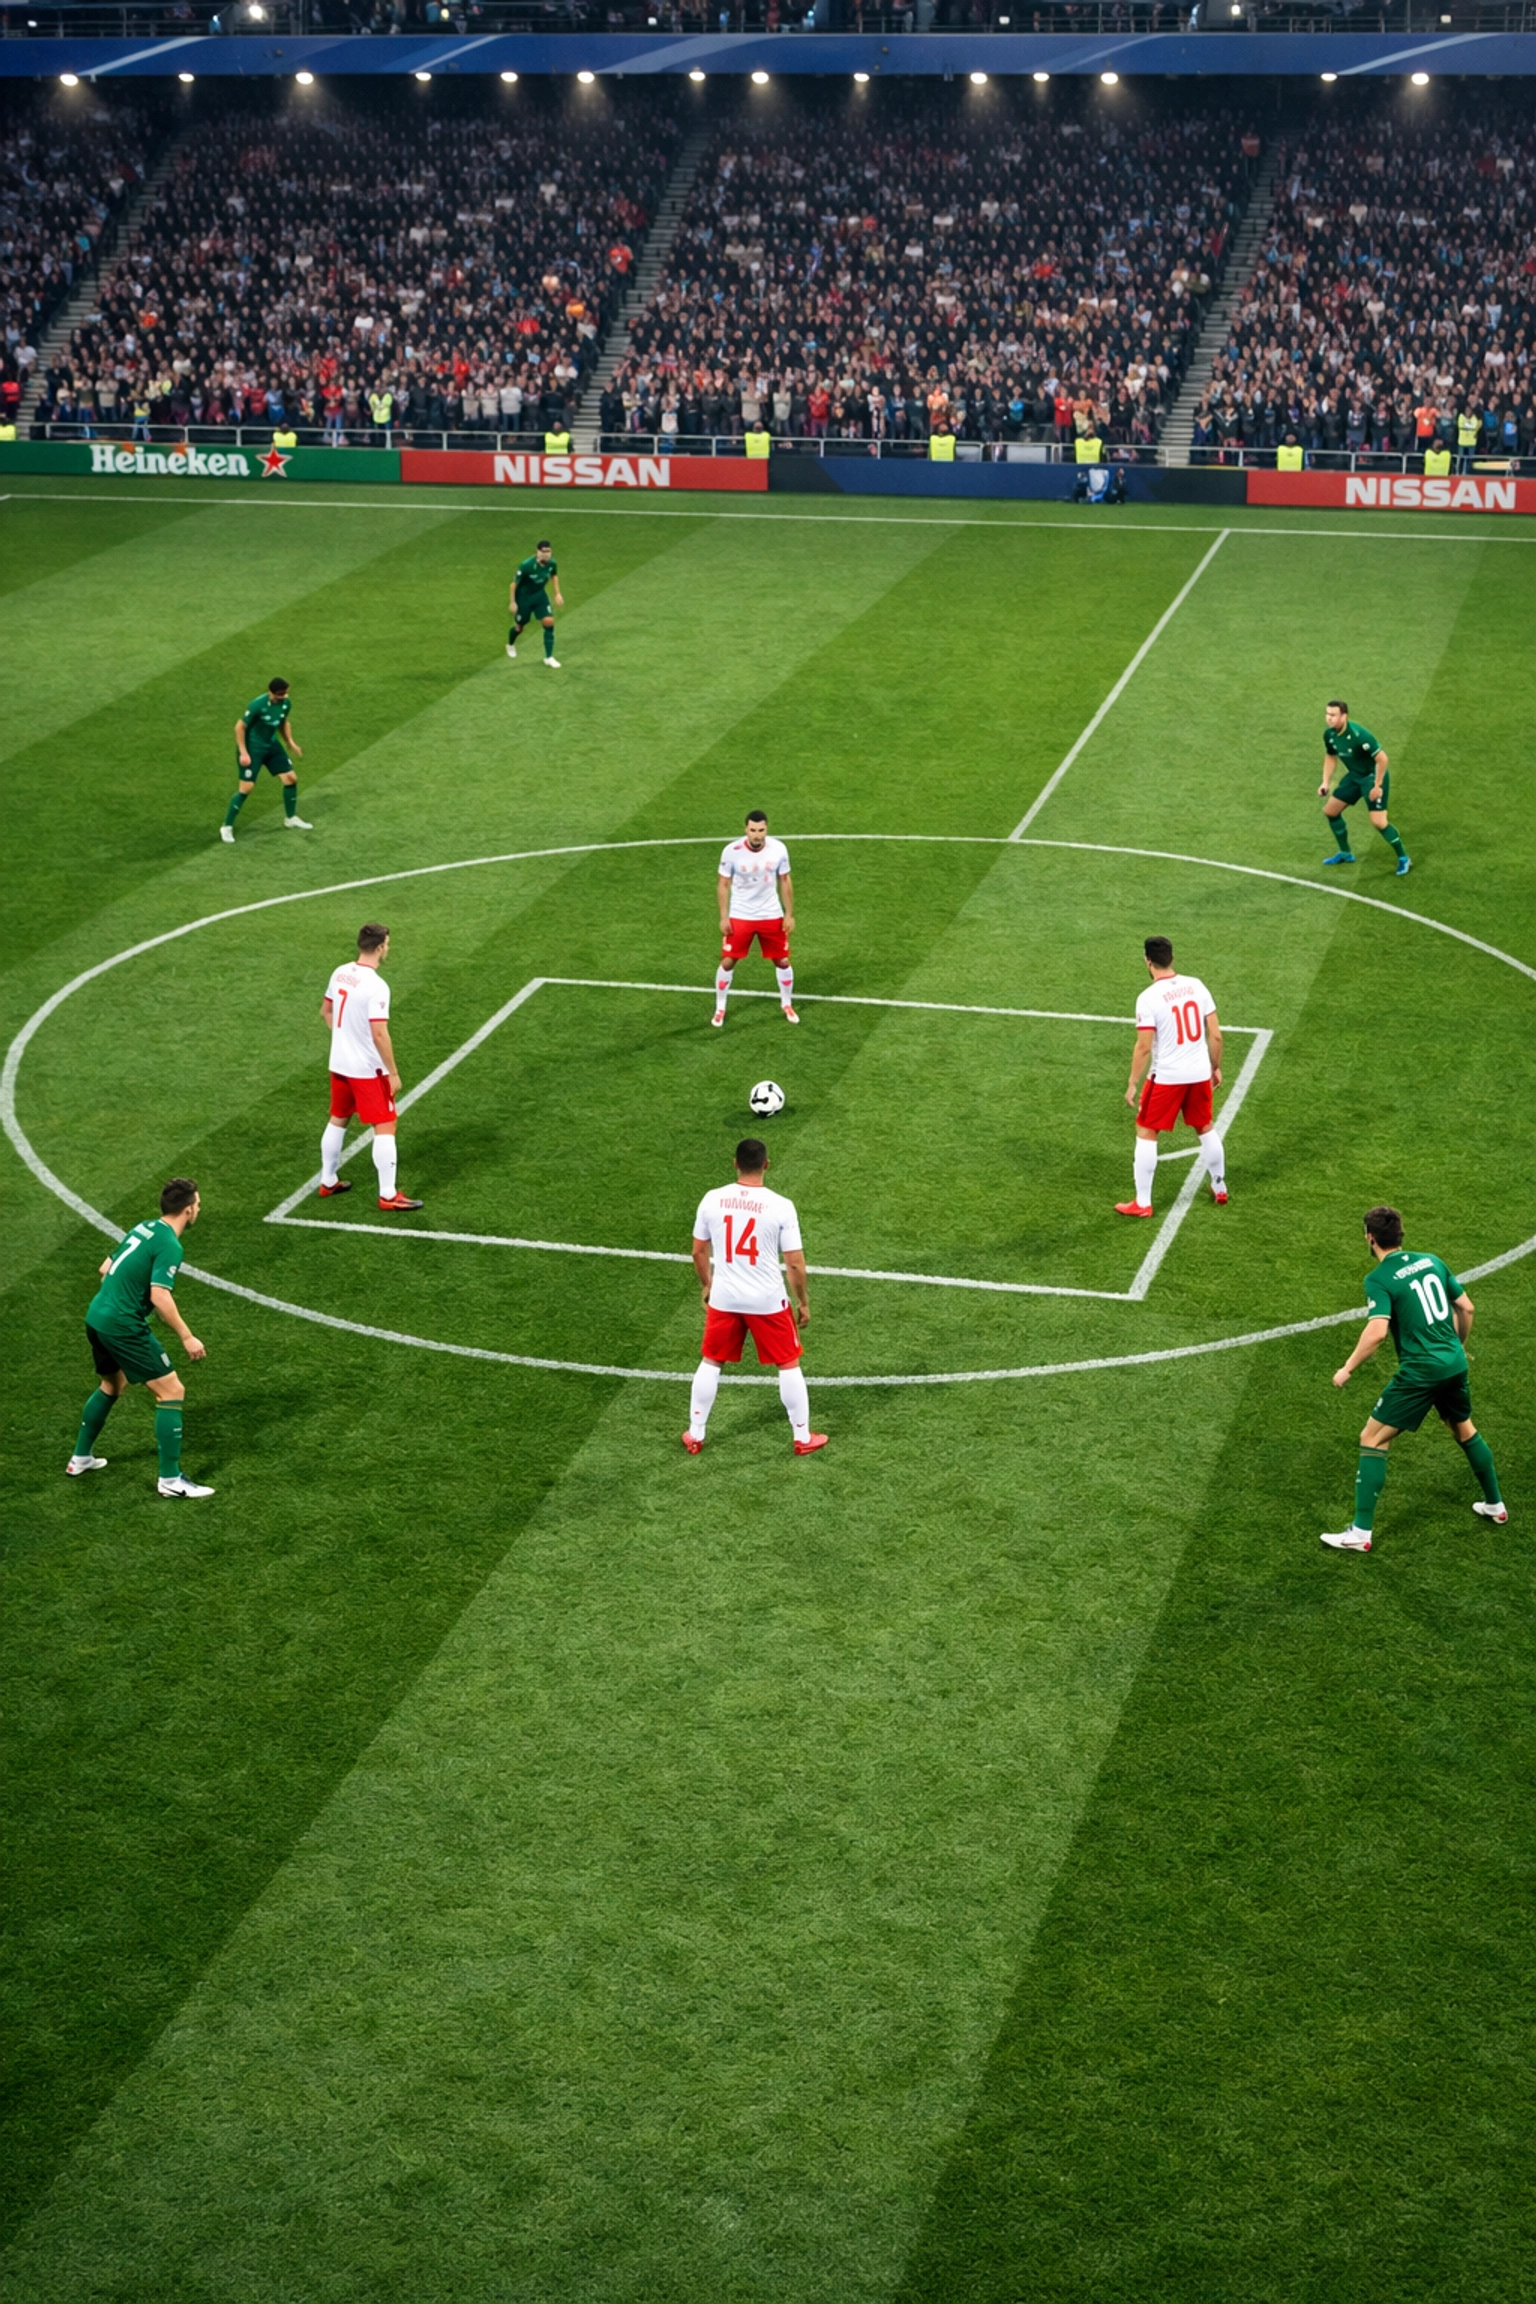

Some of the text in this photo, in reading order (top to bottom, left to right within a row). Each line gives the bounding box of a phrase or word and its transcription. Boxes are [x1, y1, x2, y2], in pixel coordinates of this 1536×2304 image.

[90, 444, 250, 476] Heineken
[494, 455, 670, 487] NISSAN
[1345, 477, 1516, 509] NISSAN
[337, 988, 348, 1028] 7
[1171, 1000, 1202, 1046] 10
[109, 1235, 142, 1275] 7
[723, 1214, 760, 1266] 14
[1408, 1273, 1449, 1326] 10
